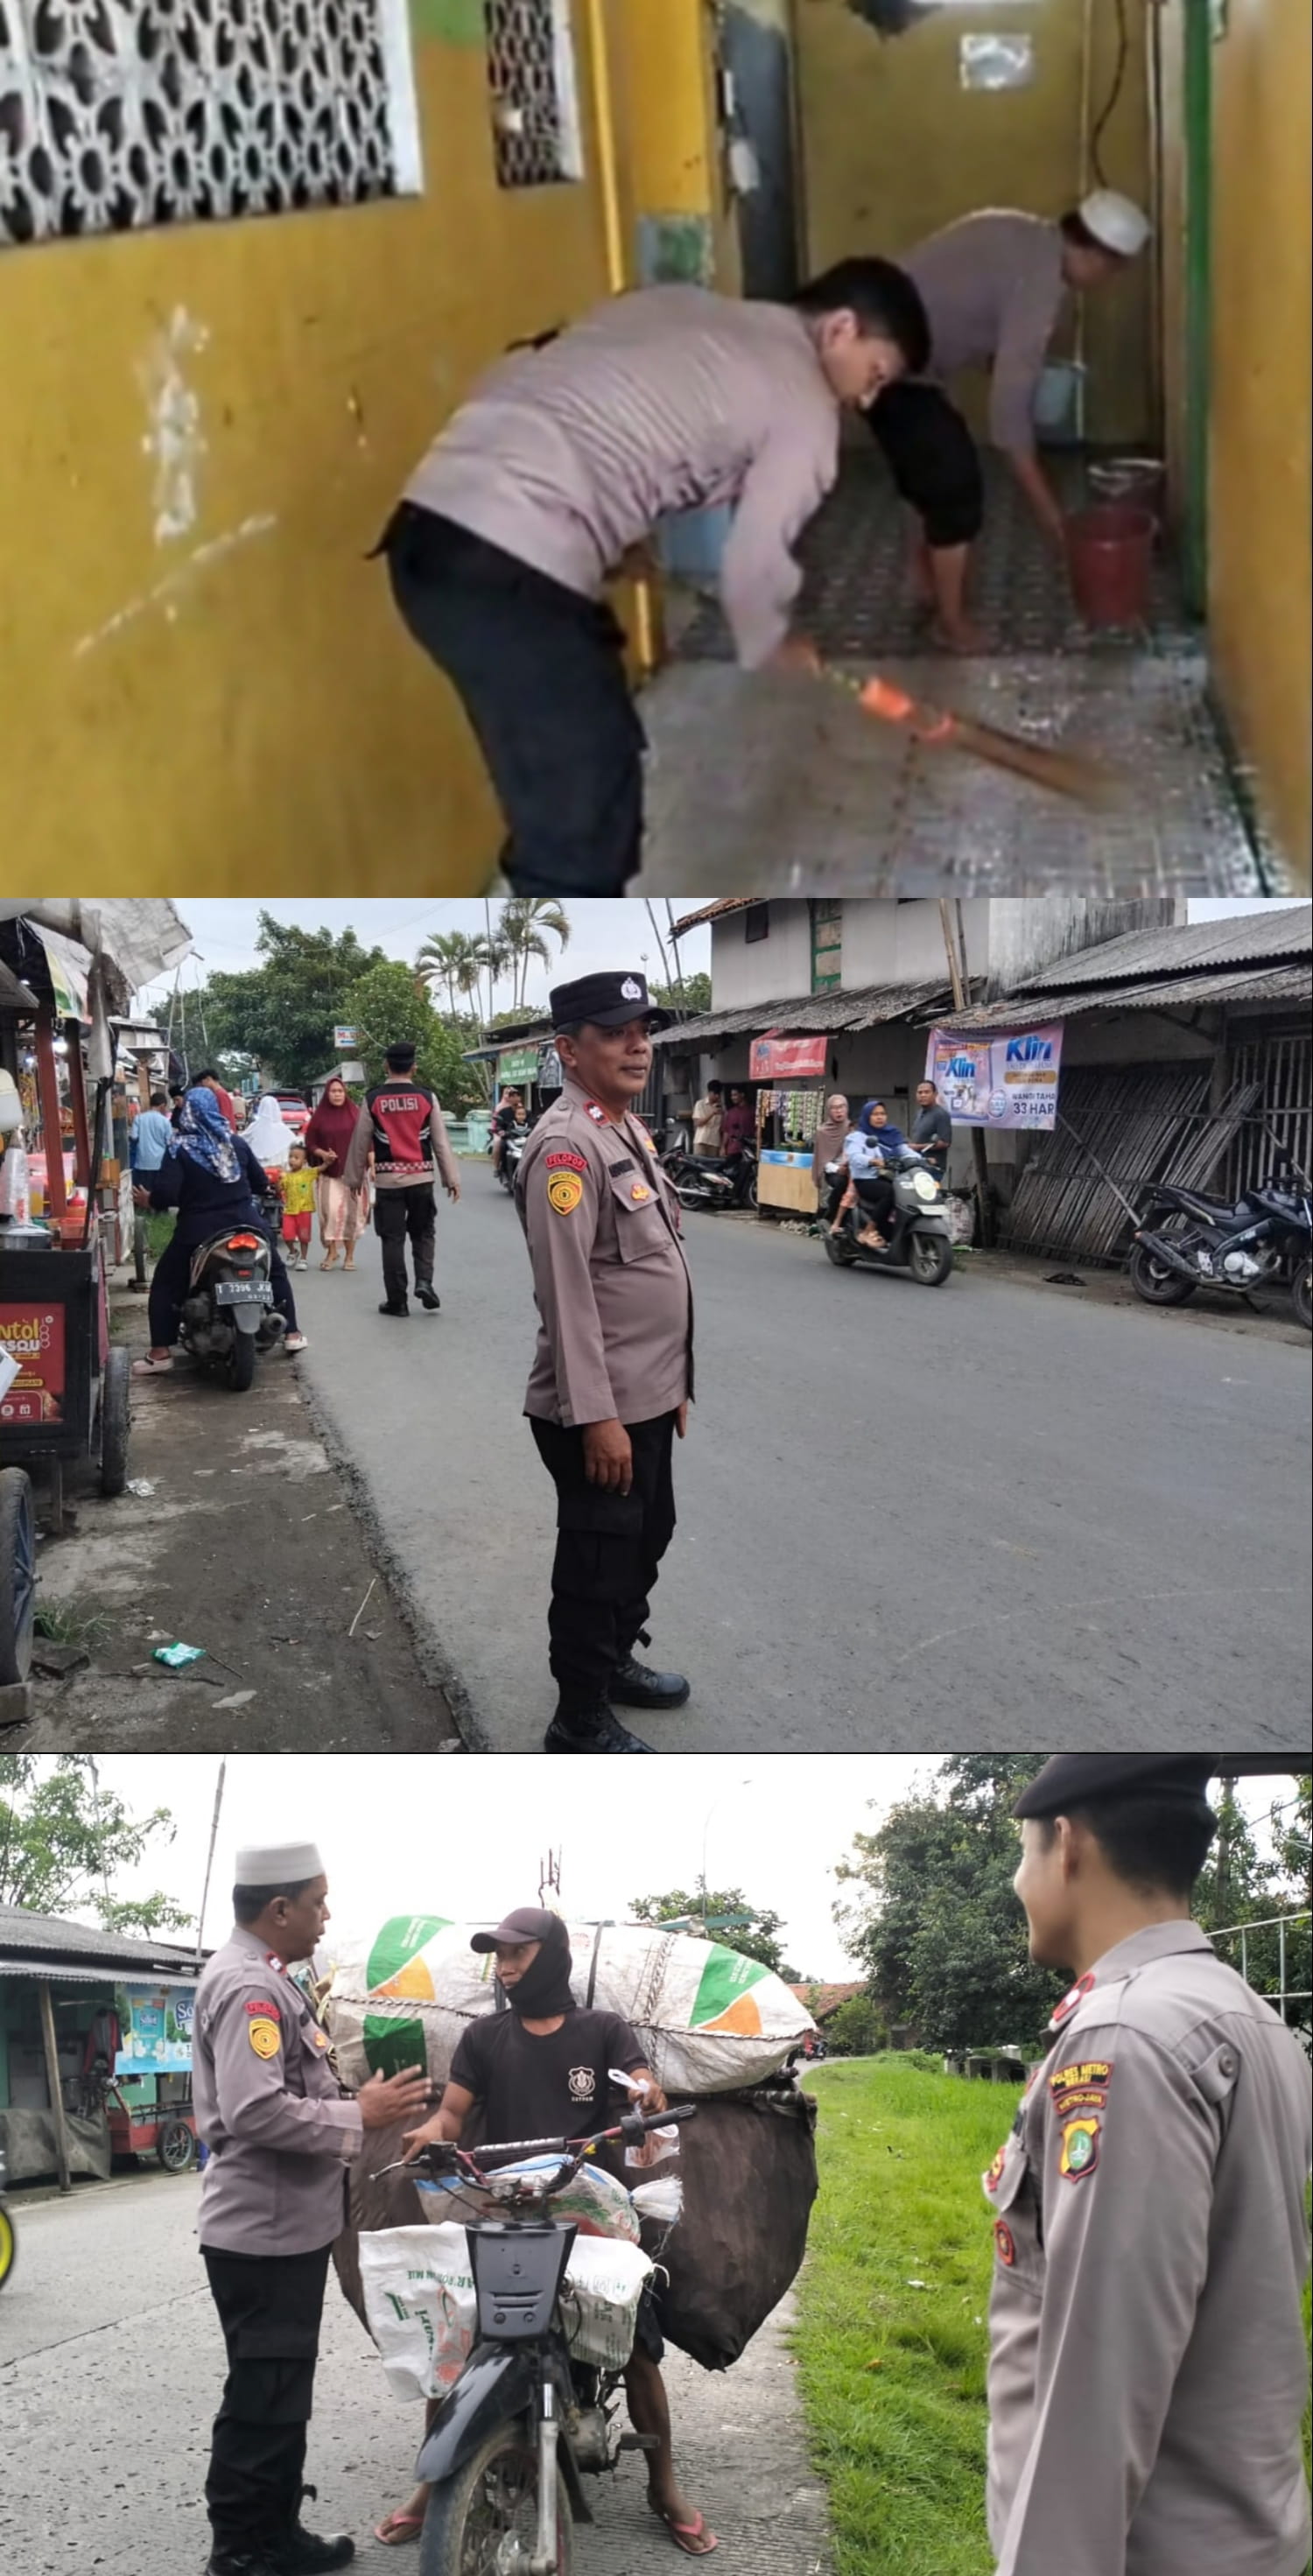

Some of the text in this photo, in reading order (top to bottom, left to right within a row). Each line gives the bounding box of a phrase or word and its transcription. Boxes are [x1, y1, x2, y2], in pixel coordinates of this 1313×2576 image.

[1006, 1036, 1052, 1062] Klin
[380, 1098, 418, 1113] POLISI
[1014, 1103, 1028, 1114] 33
[1081, 2063, 1109, 2075] METRO
